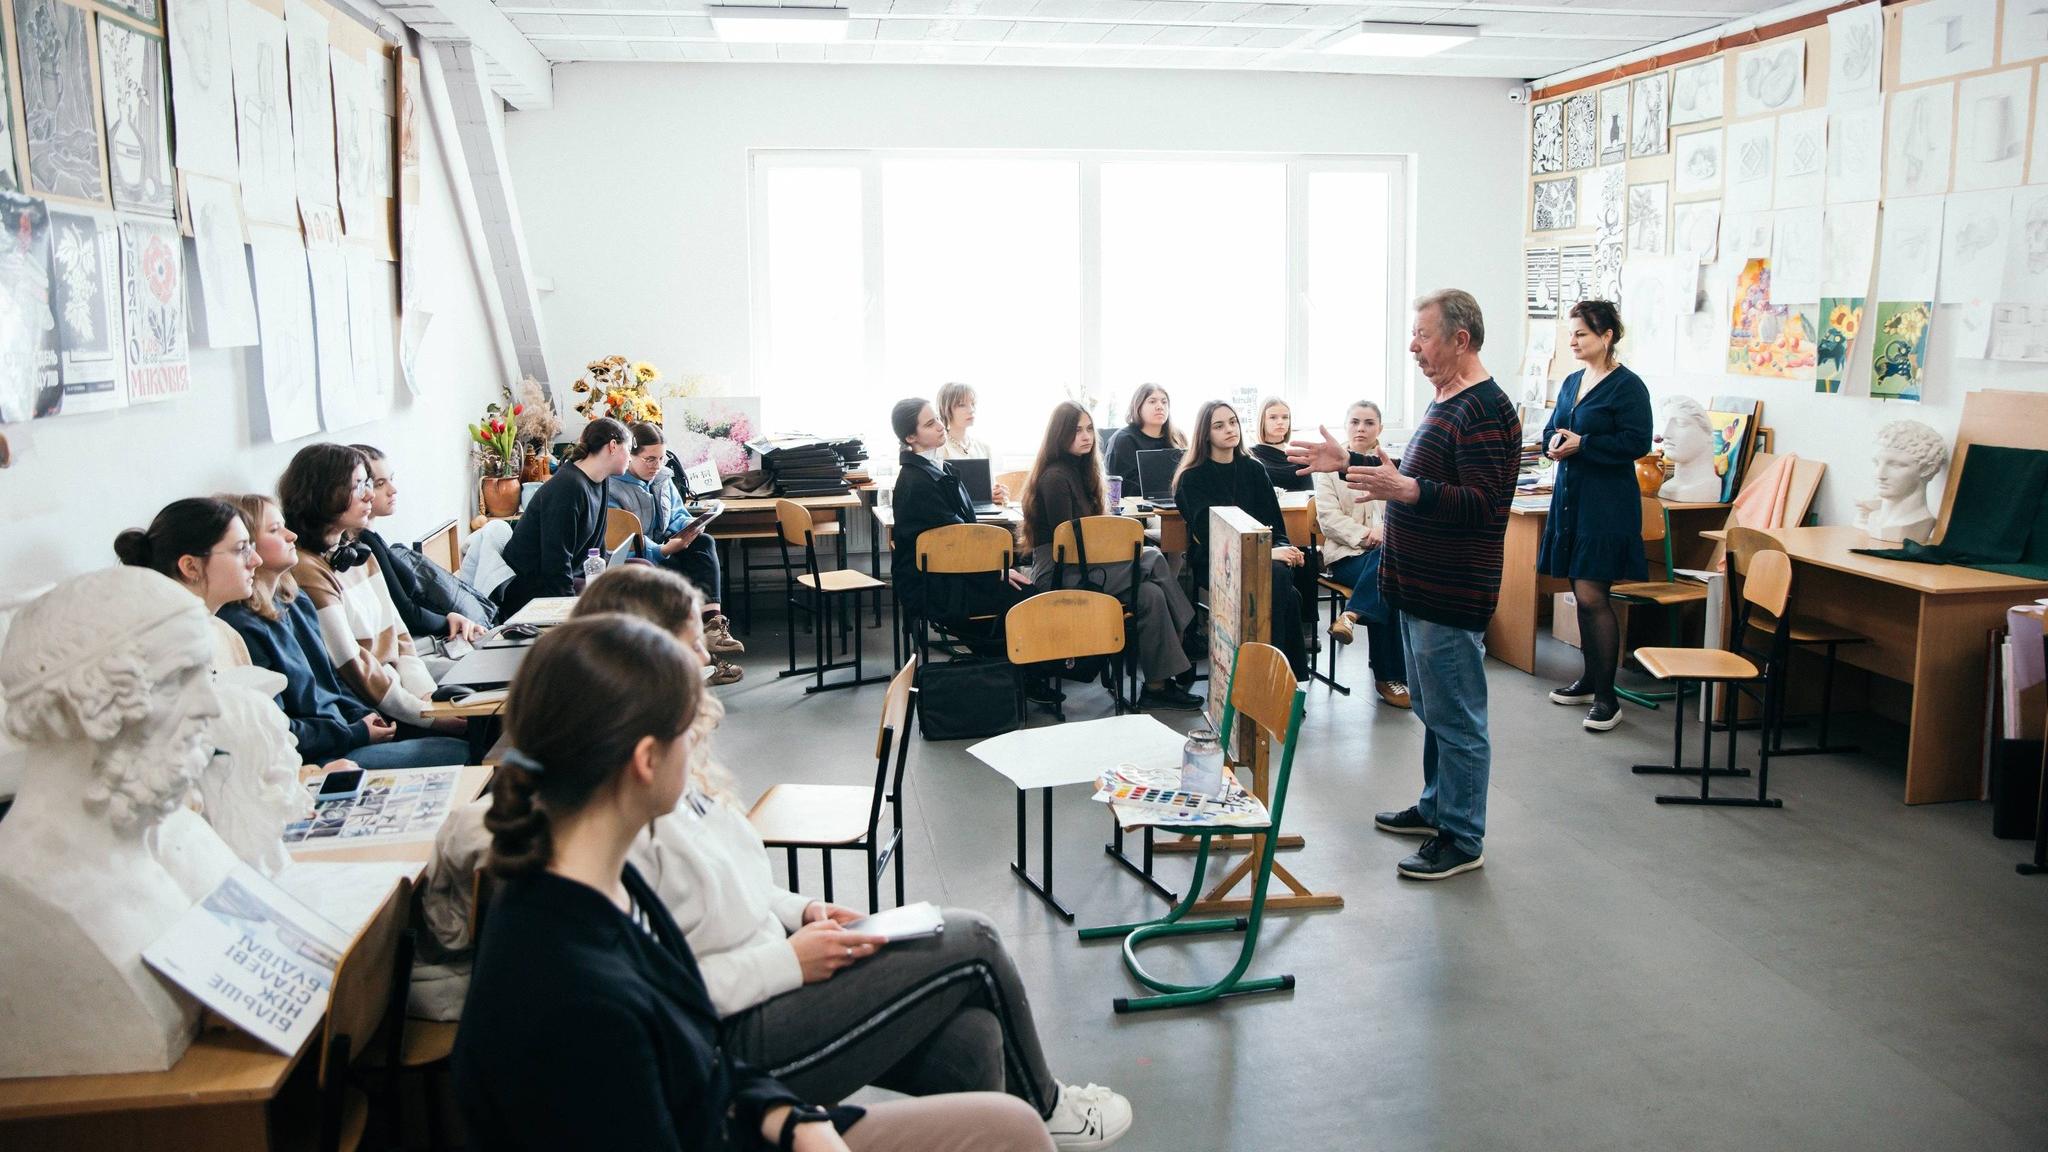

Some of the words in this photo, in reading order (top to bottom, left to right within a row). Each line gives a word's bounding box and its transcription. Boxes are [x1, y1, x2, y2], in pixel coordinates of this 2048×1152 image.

[130, 364, 189, 397] МАКОВІЯ
[224, 945, 313, 1006] СТАЛЕВІ
[238, 934, 322, 993] БУДІВЛІ
[207, 973, 294, 1033] БІЛЬШЕ
[257, 985, 303, 1019] НІЖ
